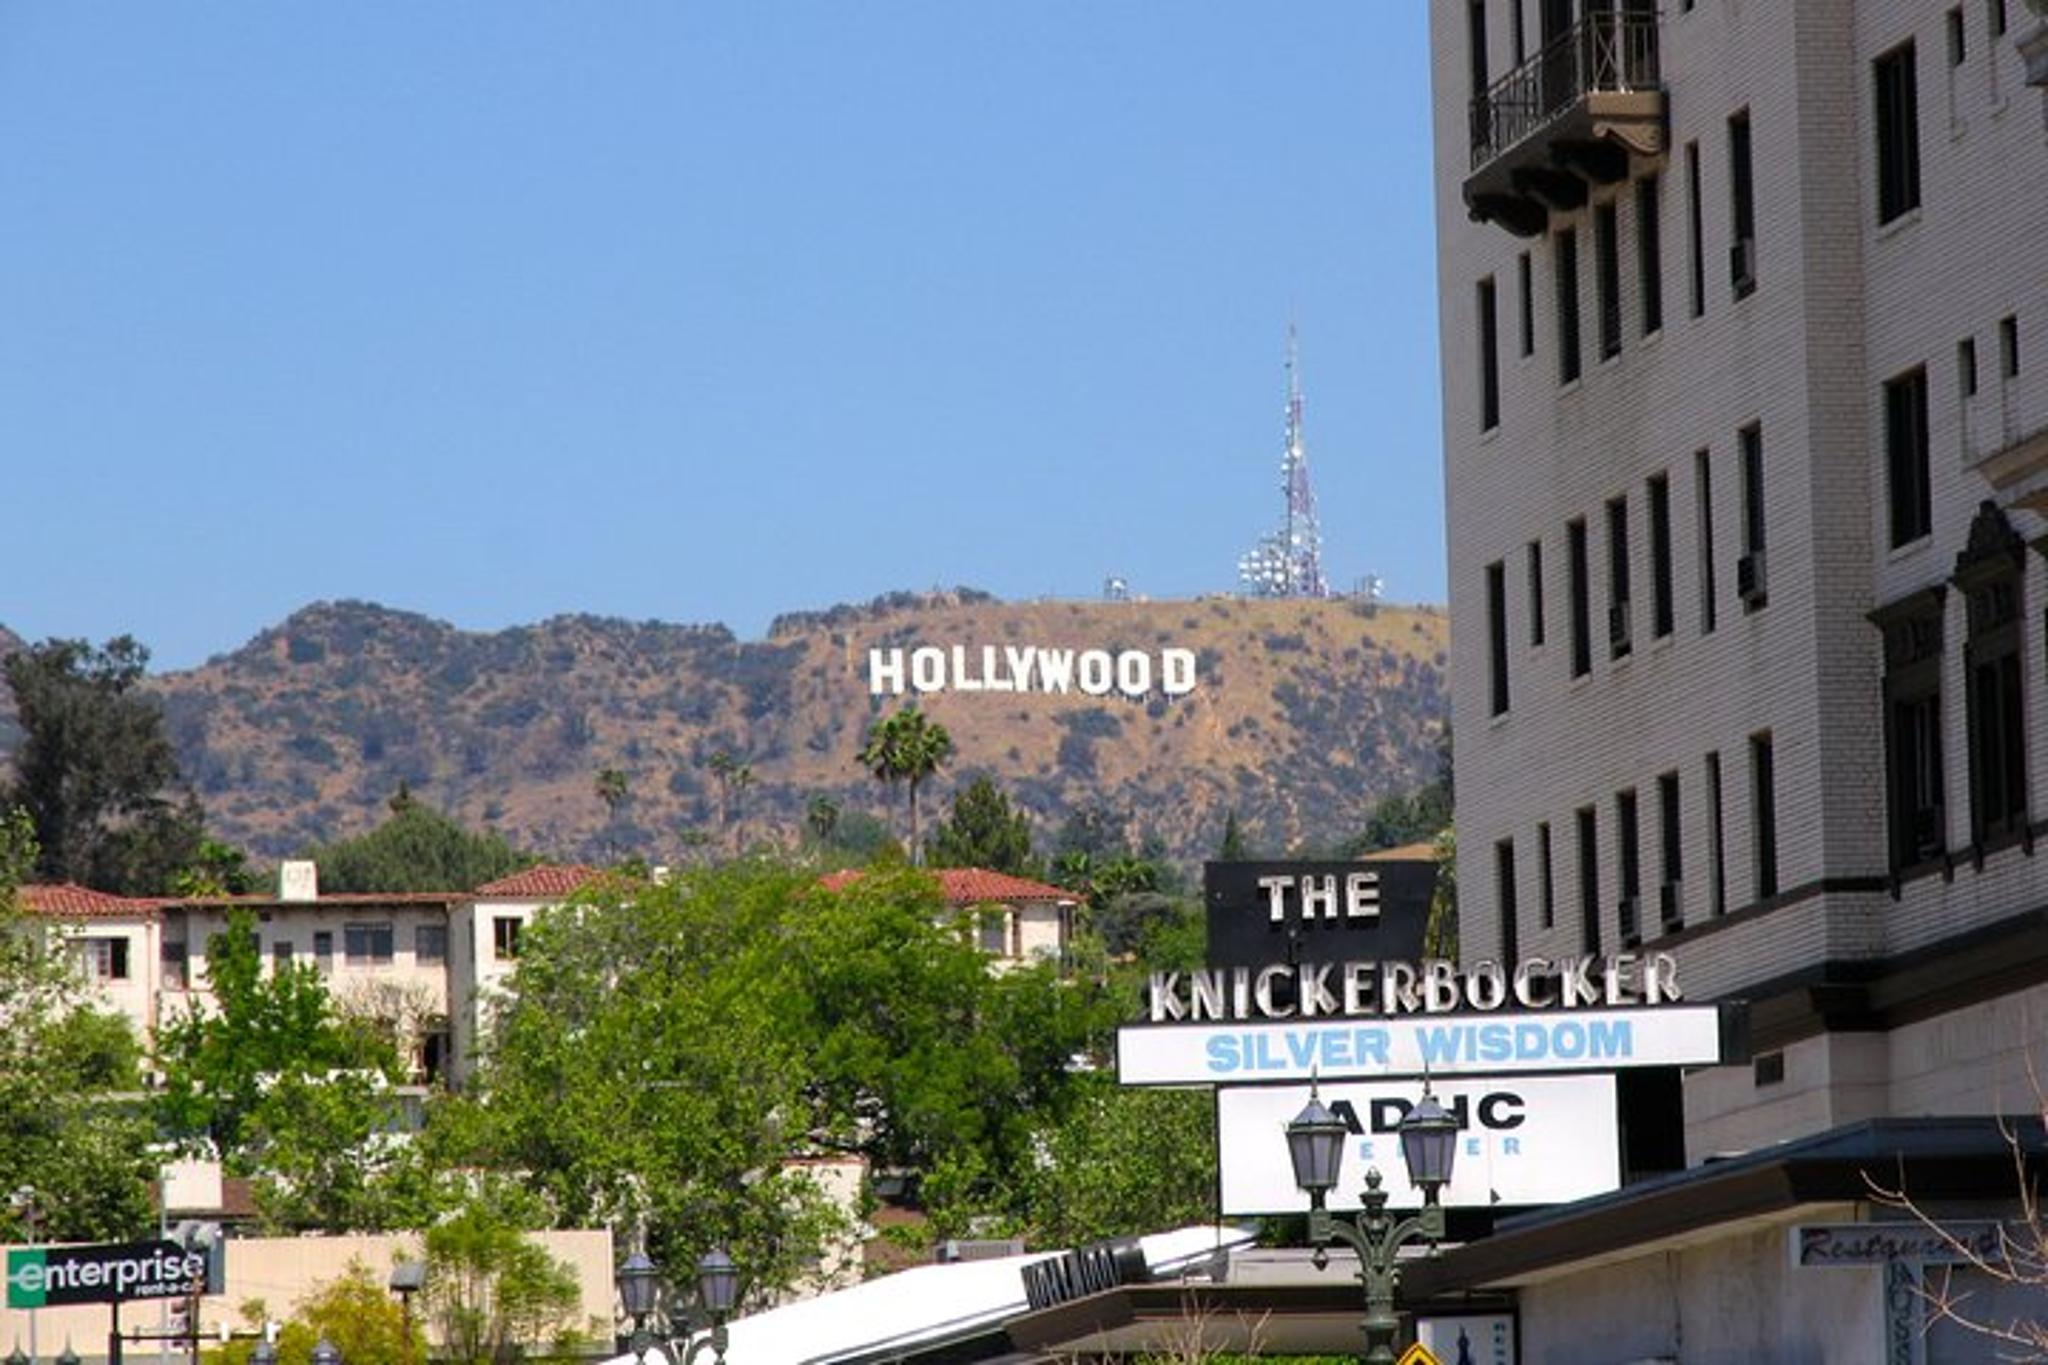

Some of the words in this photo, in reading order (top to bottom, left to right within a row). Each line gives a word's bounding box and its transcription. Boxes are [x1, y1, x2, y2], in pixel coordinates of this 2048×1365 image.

[869, 645, 1196, 694] HOLLYWOOD
[1258, 871, 1381, 923] THE
[1149, 951, 1683, 1022] KNICKERBOCKER
[1206, 1028, 1389, 1074] SILVER
[1415, 1020, 1633, 1066] WISDOM
[8, 1249, 204, 1292] enterprise
